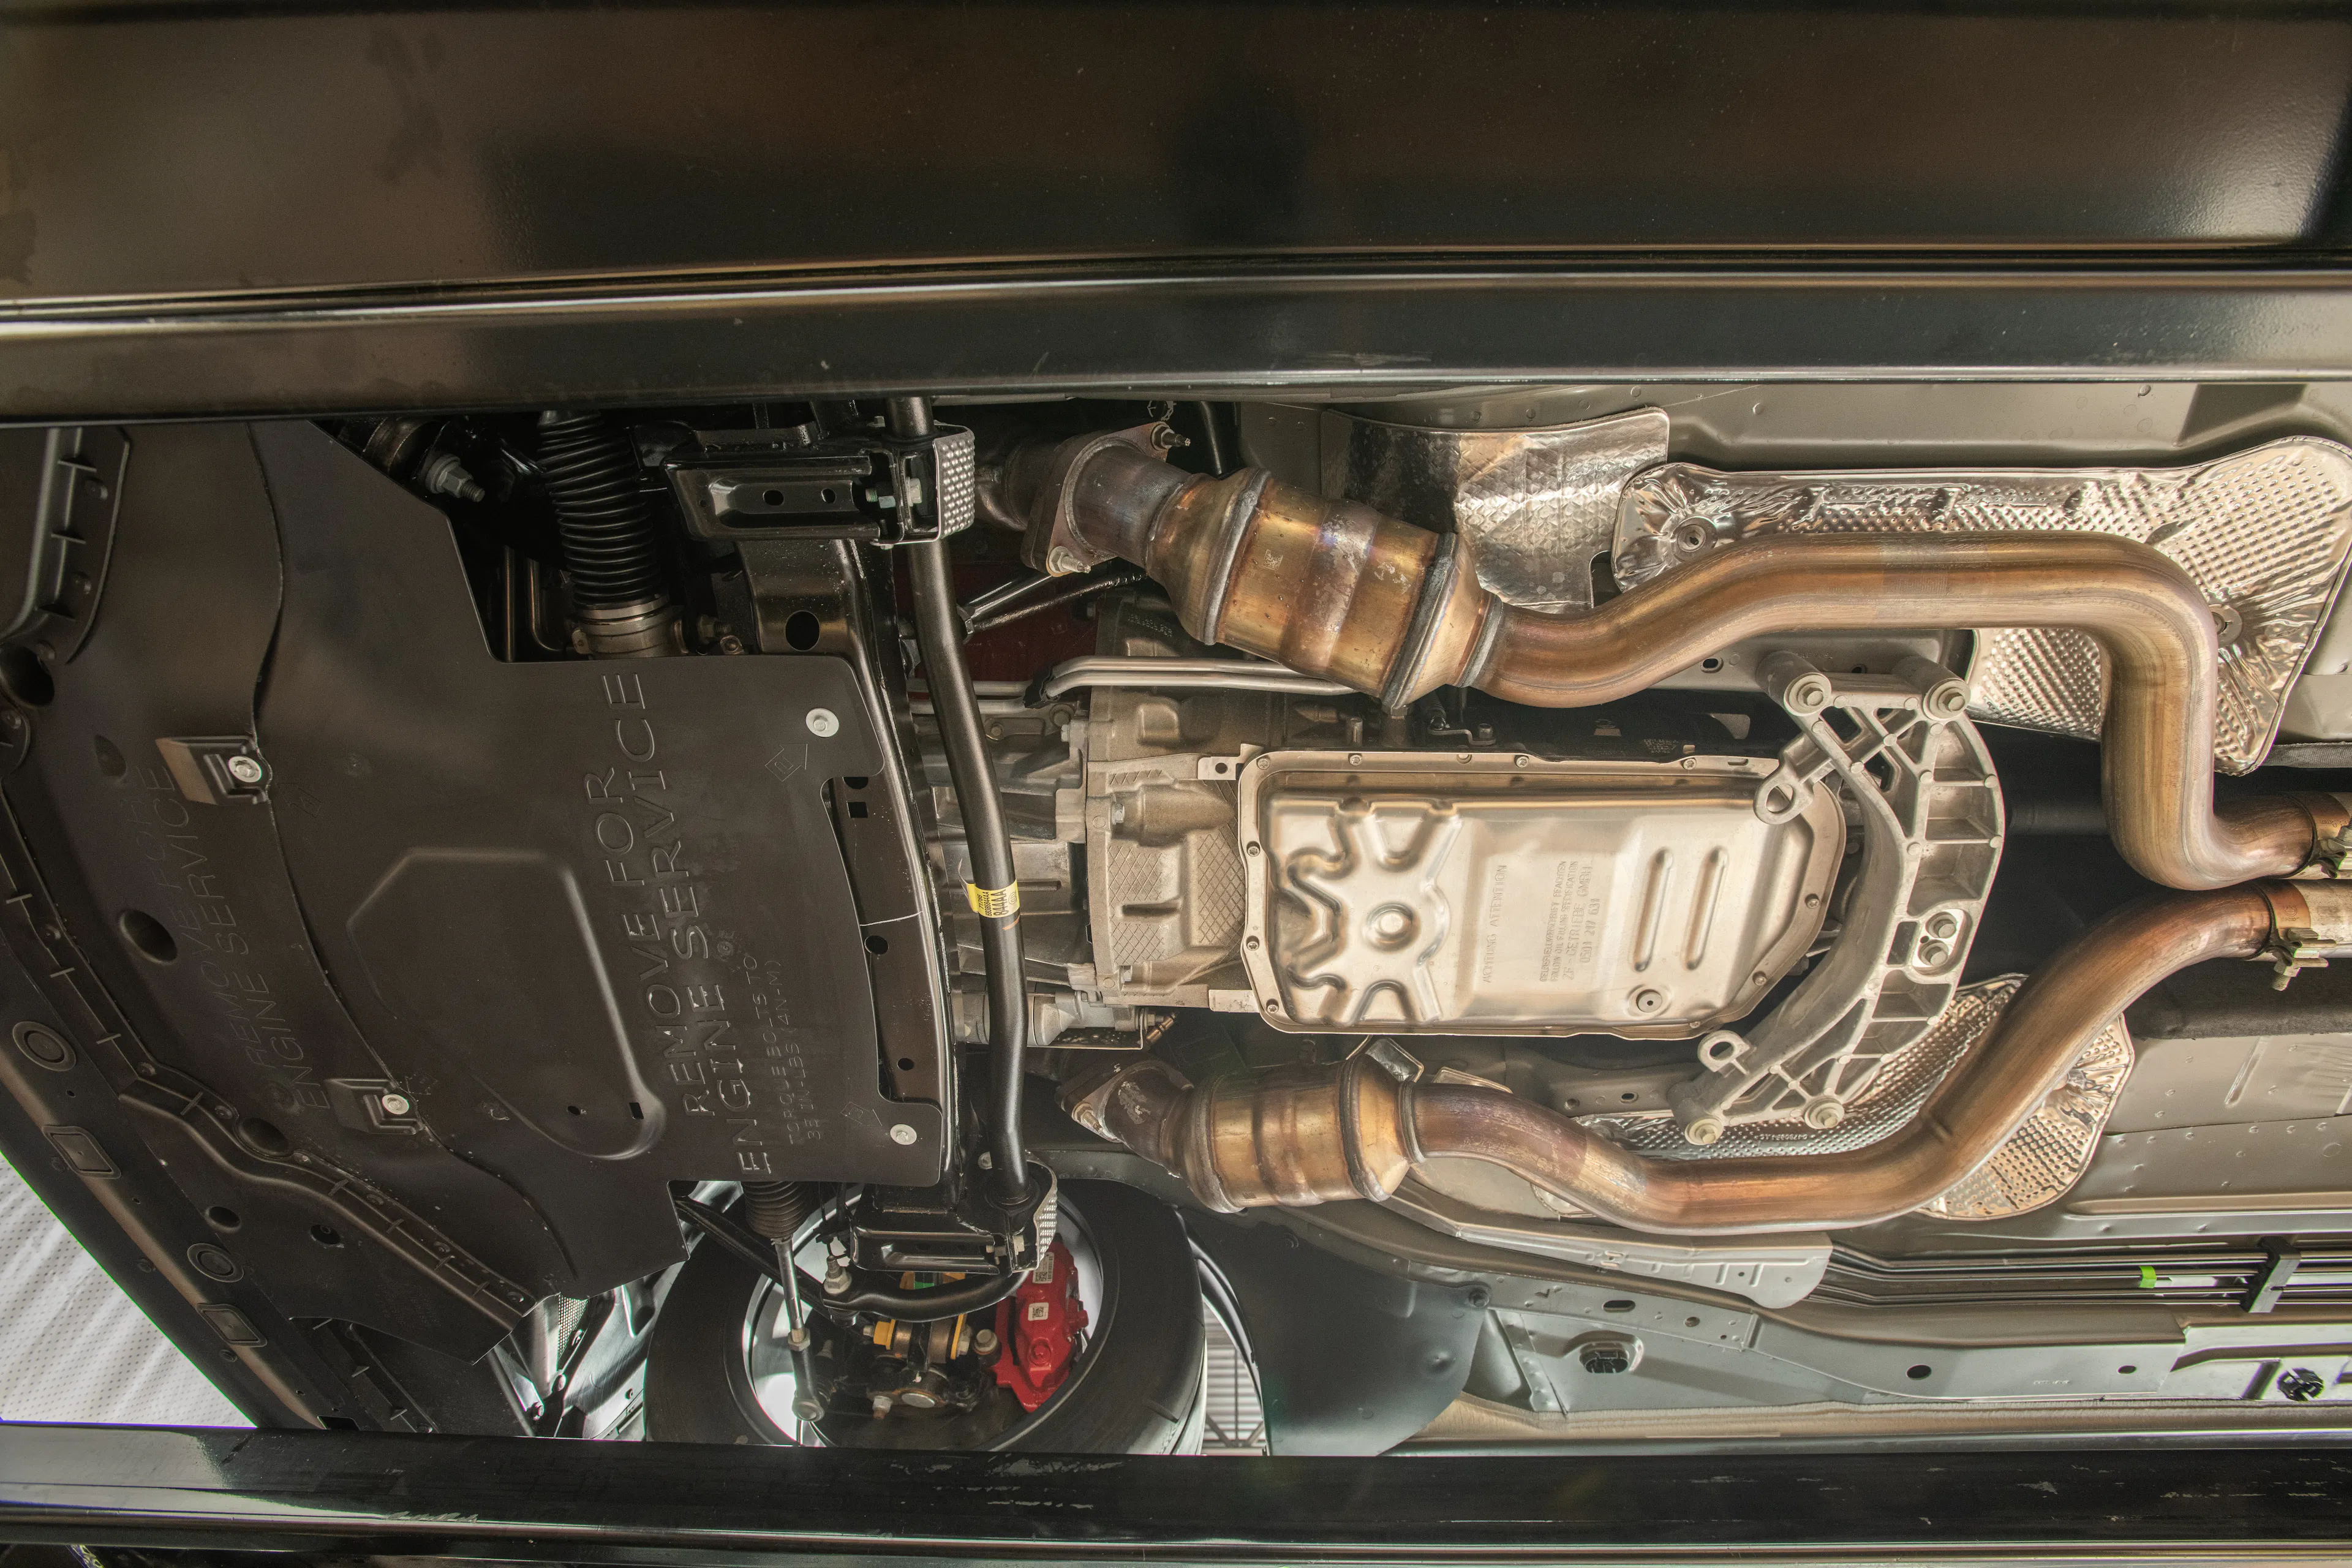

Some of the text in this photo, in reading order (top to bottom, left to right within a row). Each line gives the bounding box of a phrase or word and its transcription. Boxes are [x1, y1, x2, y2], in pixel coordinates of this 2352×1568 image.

[138, 766, 331, 1109] ENGINE SERVICE
[602, 673, 773, 1175] ENGINE SERVICE
[990, 889, 1009, 916] 844AA
[1482, 865, 1507, 983] ACHTUNG ATTENTION
[1550, 861, 1579, 982] FOLLOW OIL FILLING SPECIFICATION
[1577, 865, 1593, 897] GMBH
[1585, 921, 1596, 937] 217
[1588, 898, 1600, 915] 631
[170, 905, 278, 1069] REMOVE
[586, 766, 716, 1117] REMOVE FOR
[763, 960, 797, 1034] (4N-M)
[742, 956, 800, 1145] TORQUE BOLTS TO
